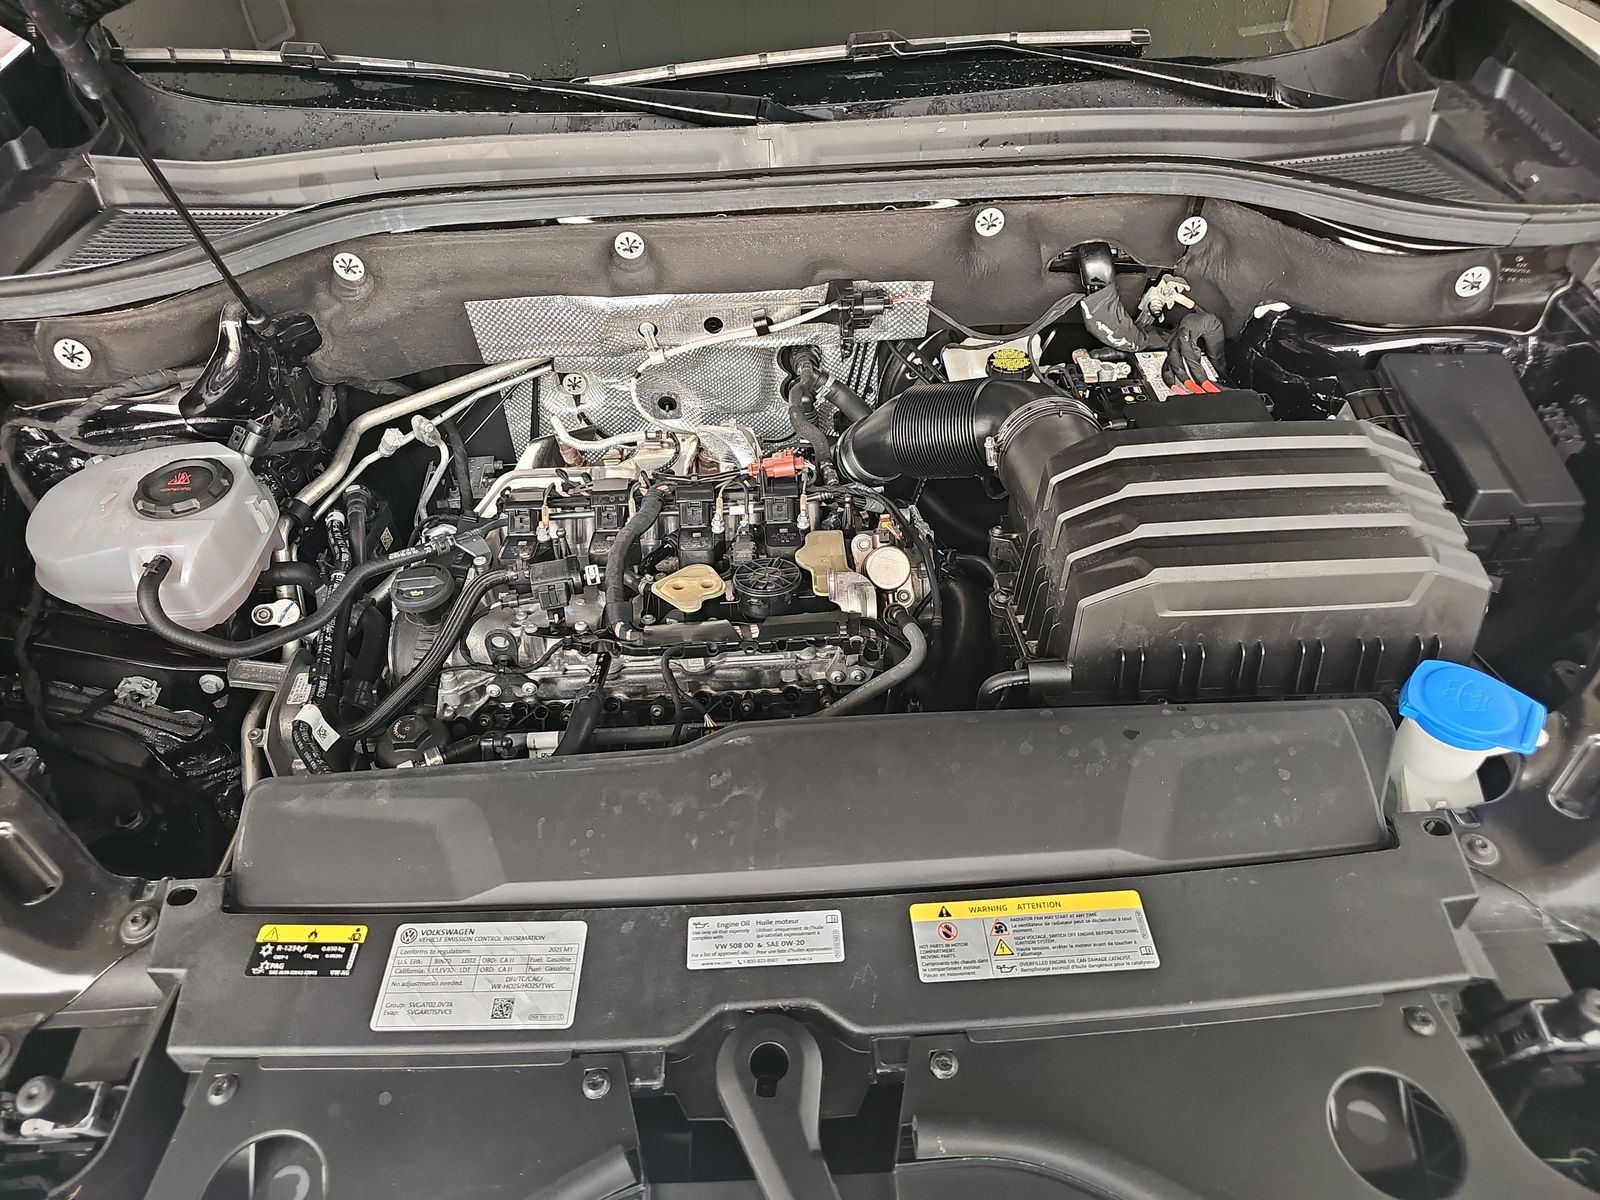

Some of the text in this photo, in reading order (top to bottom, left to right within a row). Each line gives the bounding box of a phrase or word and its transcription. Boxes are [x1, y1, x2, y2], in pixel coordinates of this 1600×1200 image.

[968, 902, 1062, 913] WARNING ATTENTION
[421, 928, 476, 936] VOLKSWAGEN
